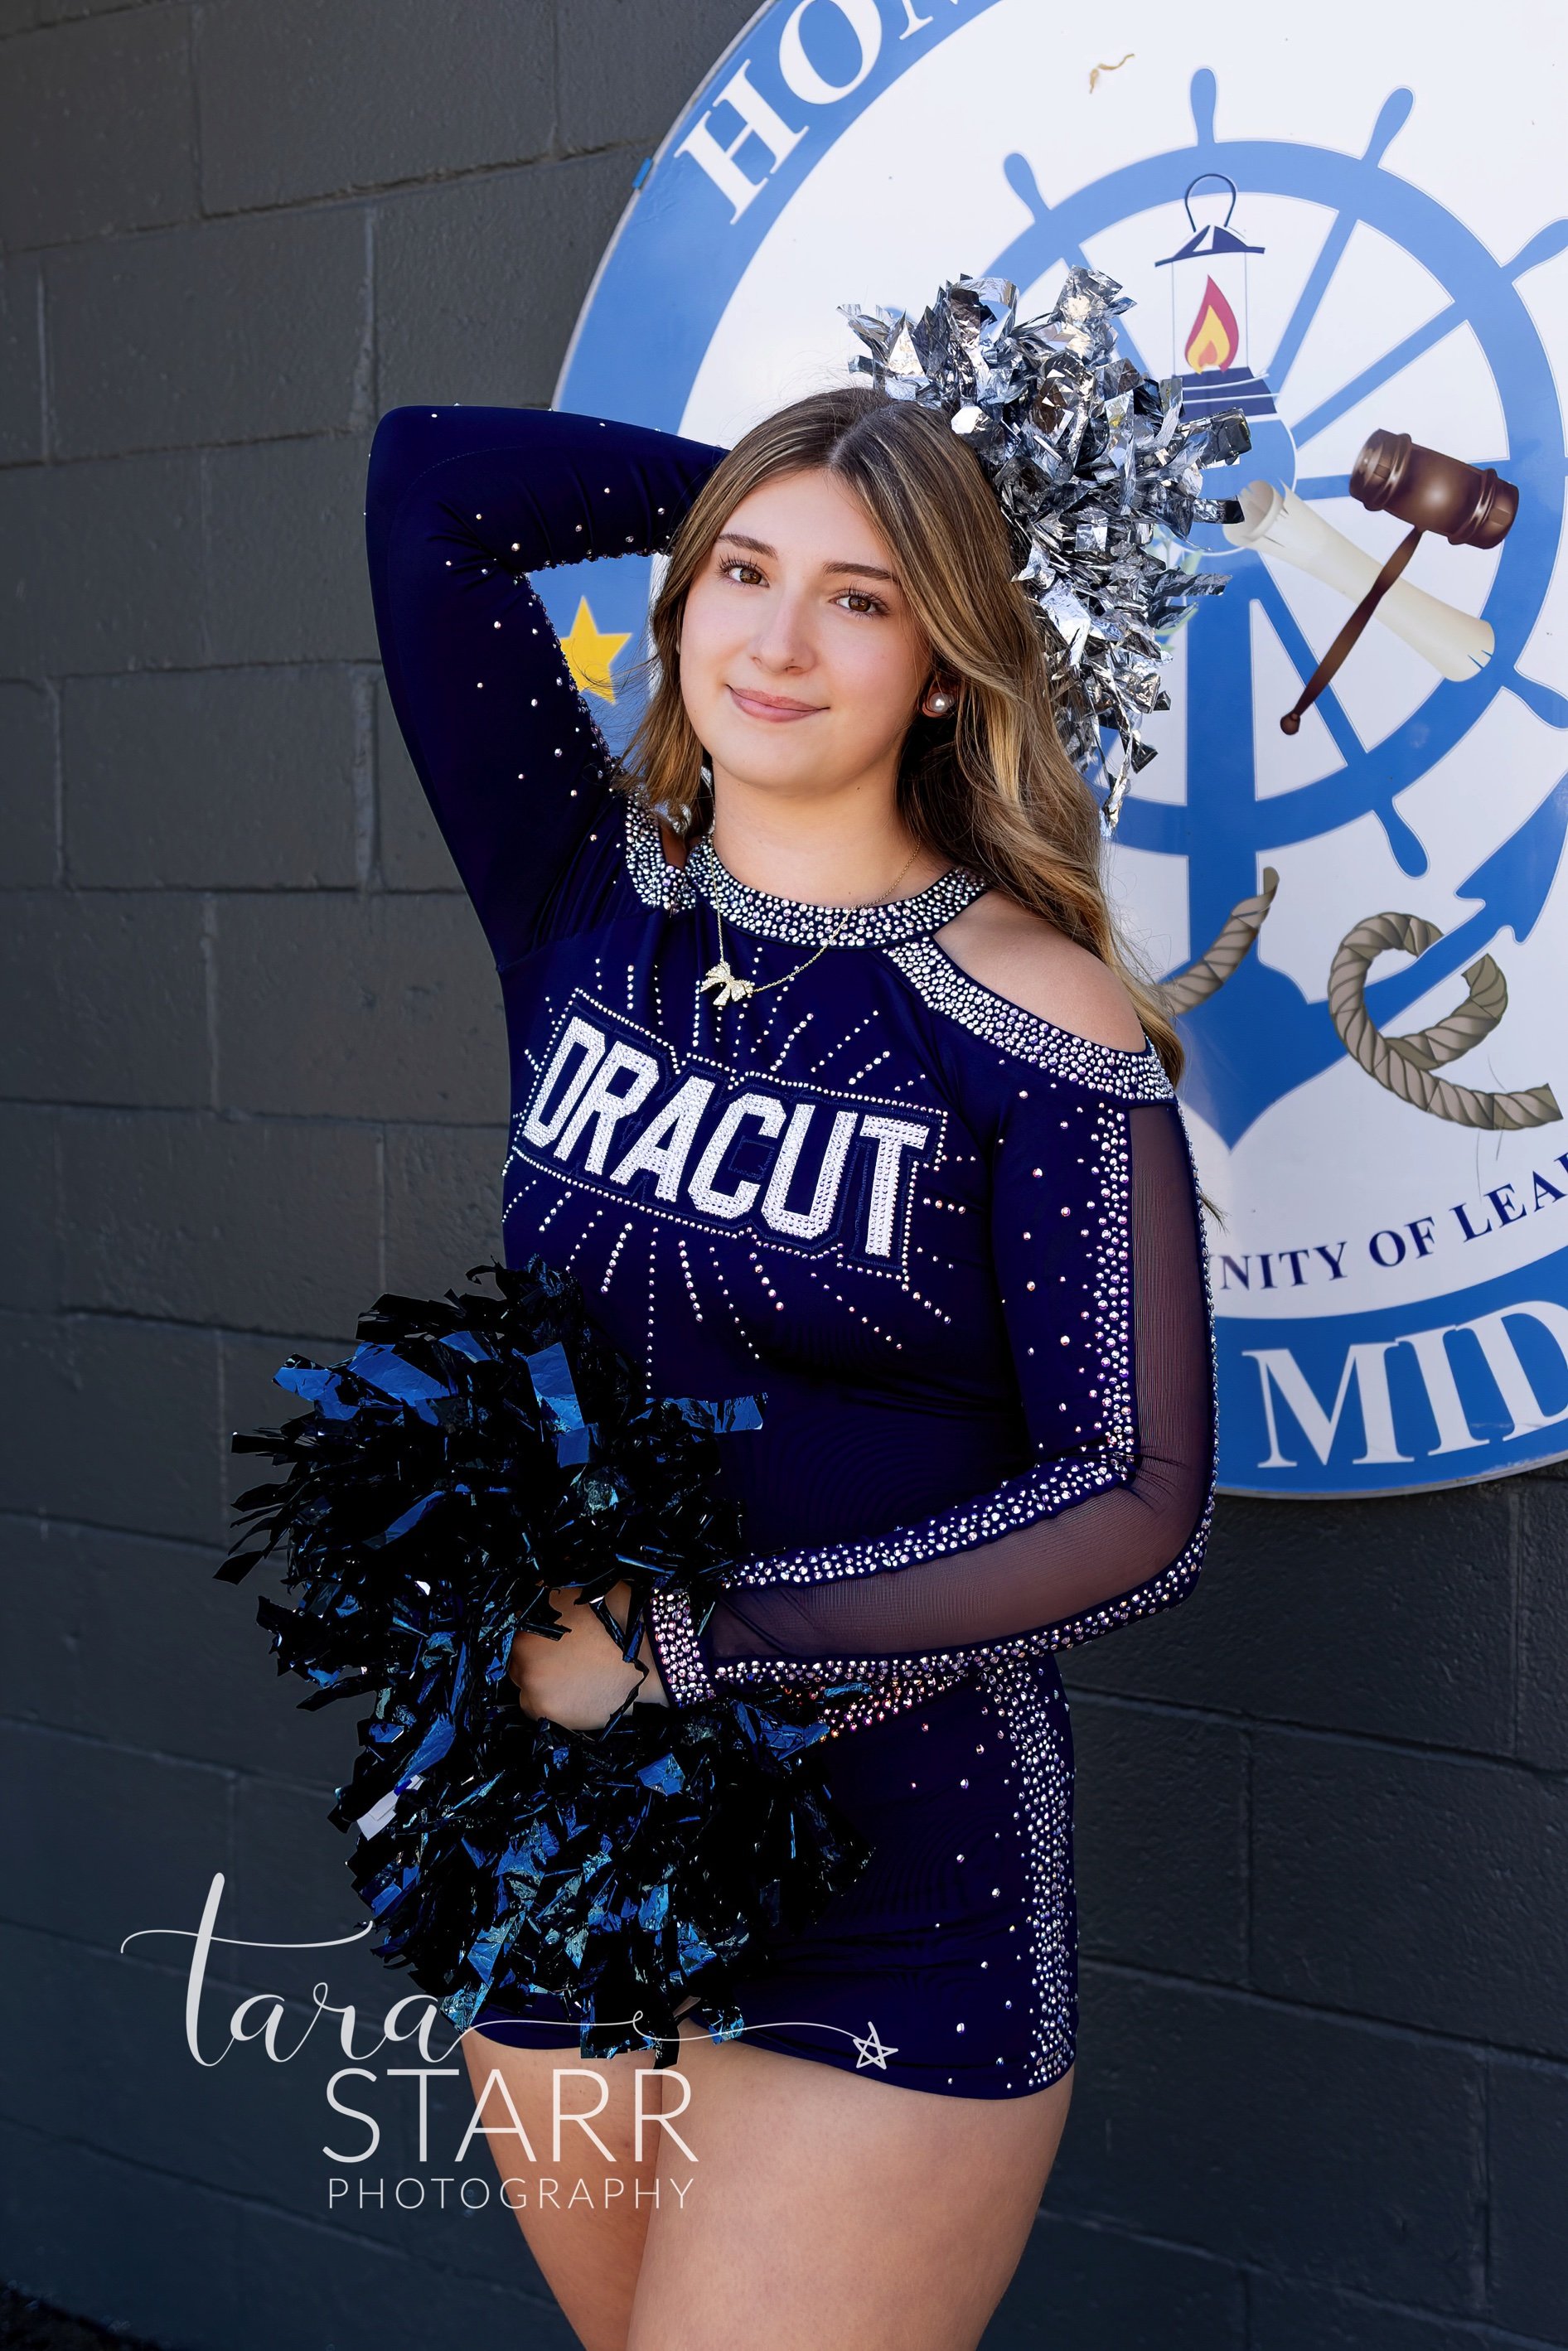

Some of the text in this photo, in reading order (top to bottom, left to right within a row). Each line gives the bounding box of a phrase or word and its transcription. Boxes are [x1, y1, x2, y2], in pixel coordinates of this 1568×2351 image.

[521, 1015, 930, 1257] DRACUT
[1208, 1241, 1348, 1291] NITY
[1368, 1216, 1437, 1269] OF
